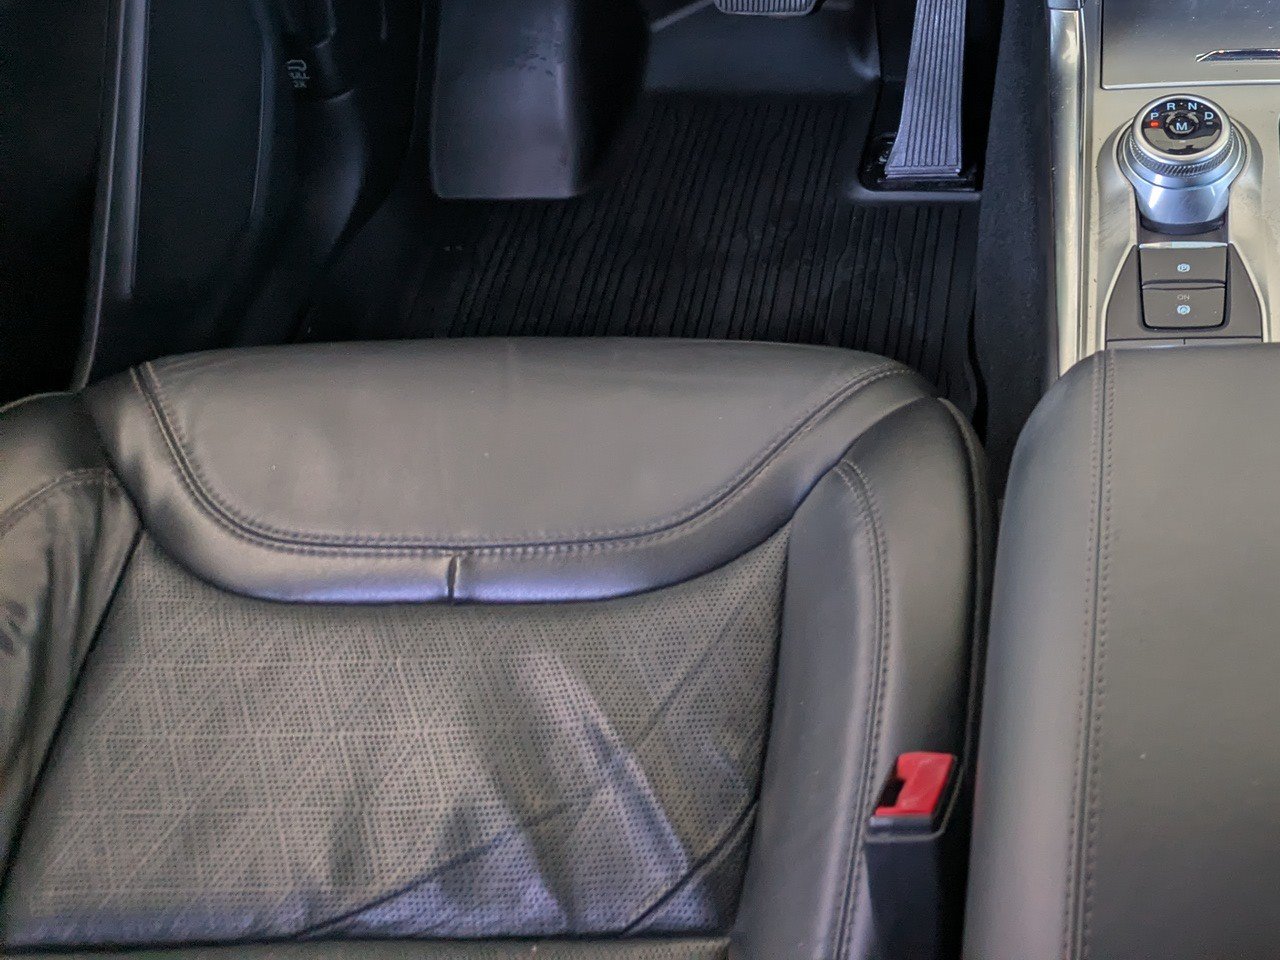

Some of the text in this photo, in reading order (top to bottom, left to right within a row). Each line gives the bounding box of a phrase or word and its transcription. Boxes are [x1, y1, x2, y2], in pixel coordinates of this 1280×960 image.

[1166, 102, 1176, 111] R
[1188, 102, 1198, 111] N
[1150, 112, 1159, 120] P
[1204, 112, 1214, 120] D
[1176, 122, 1188, 132] M
